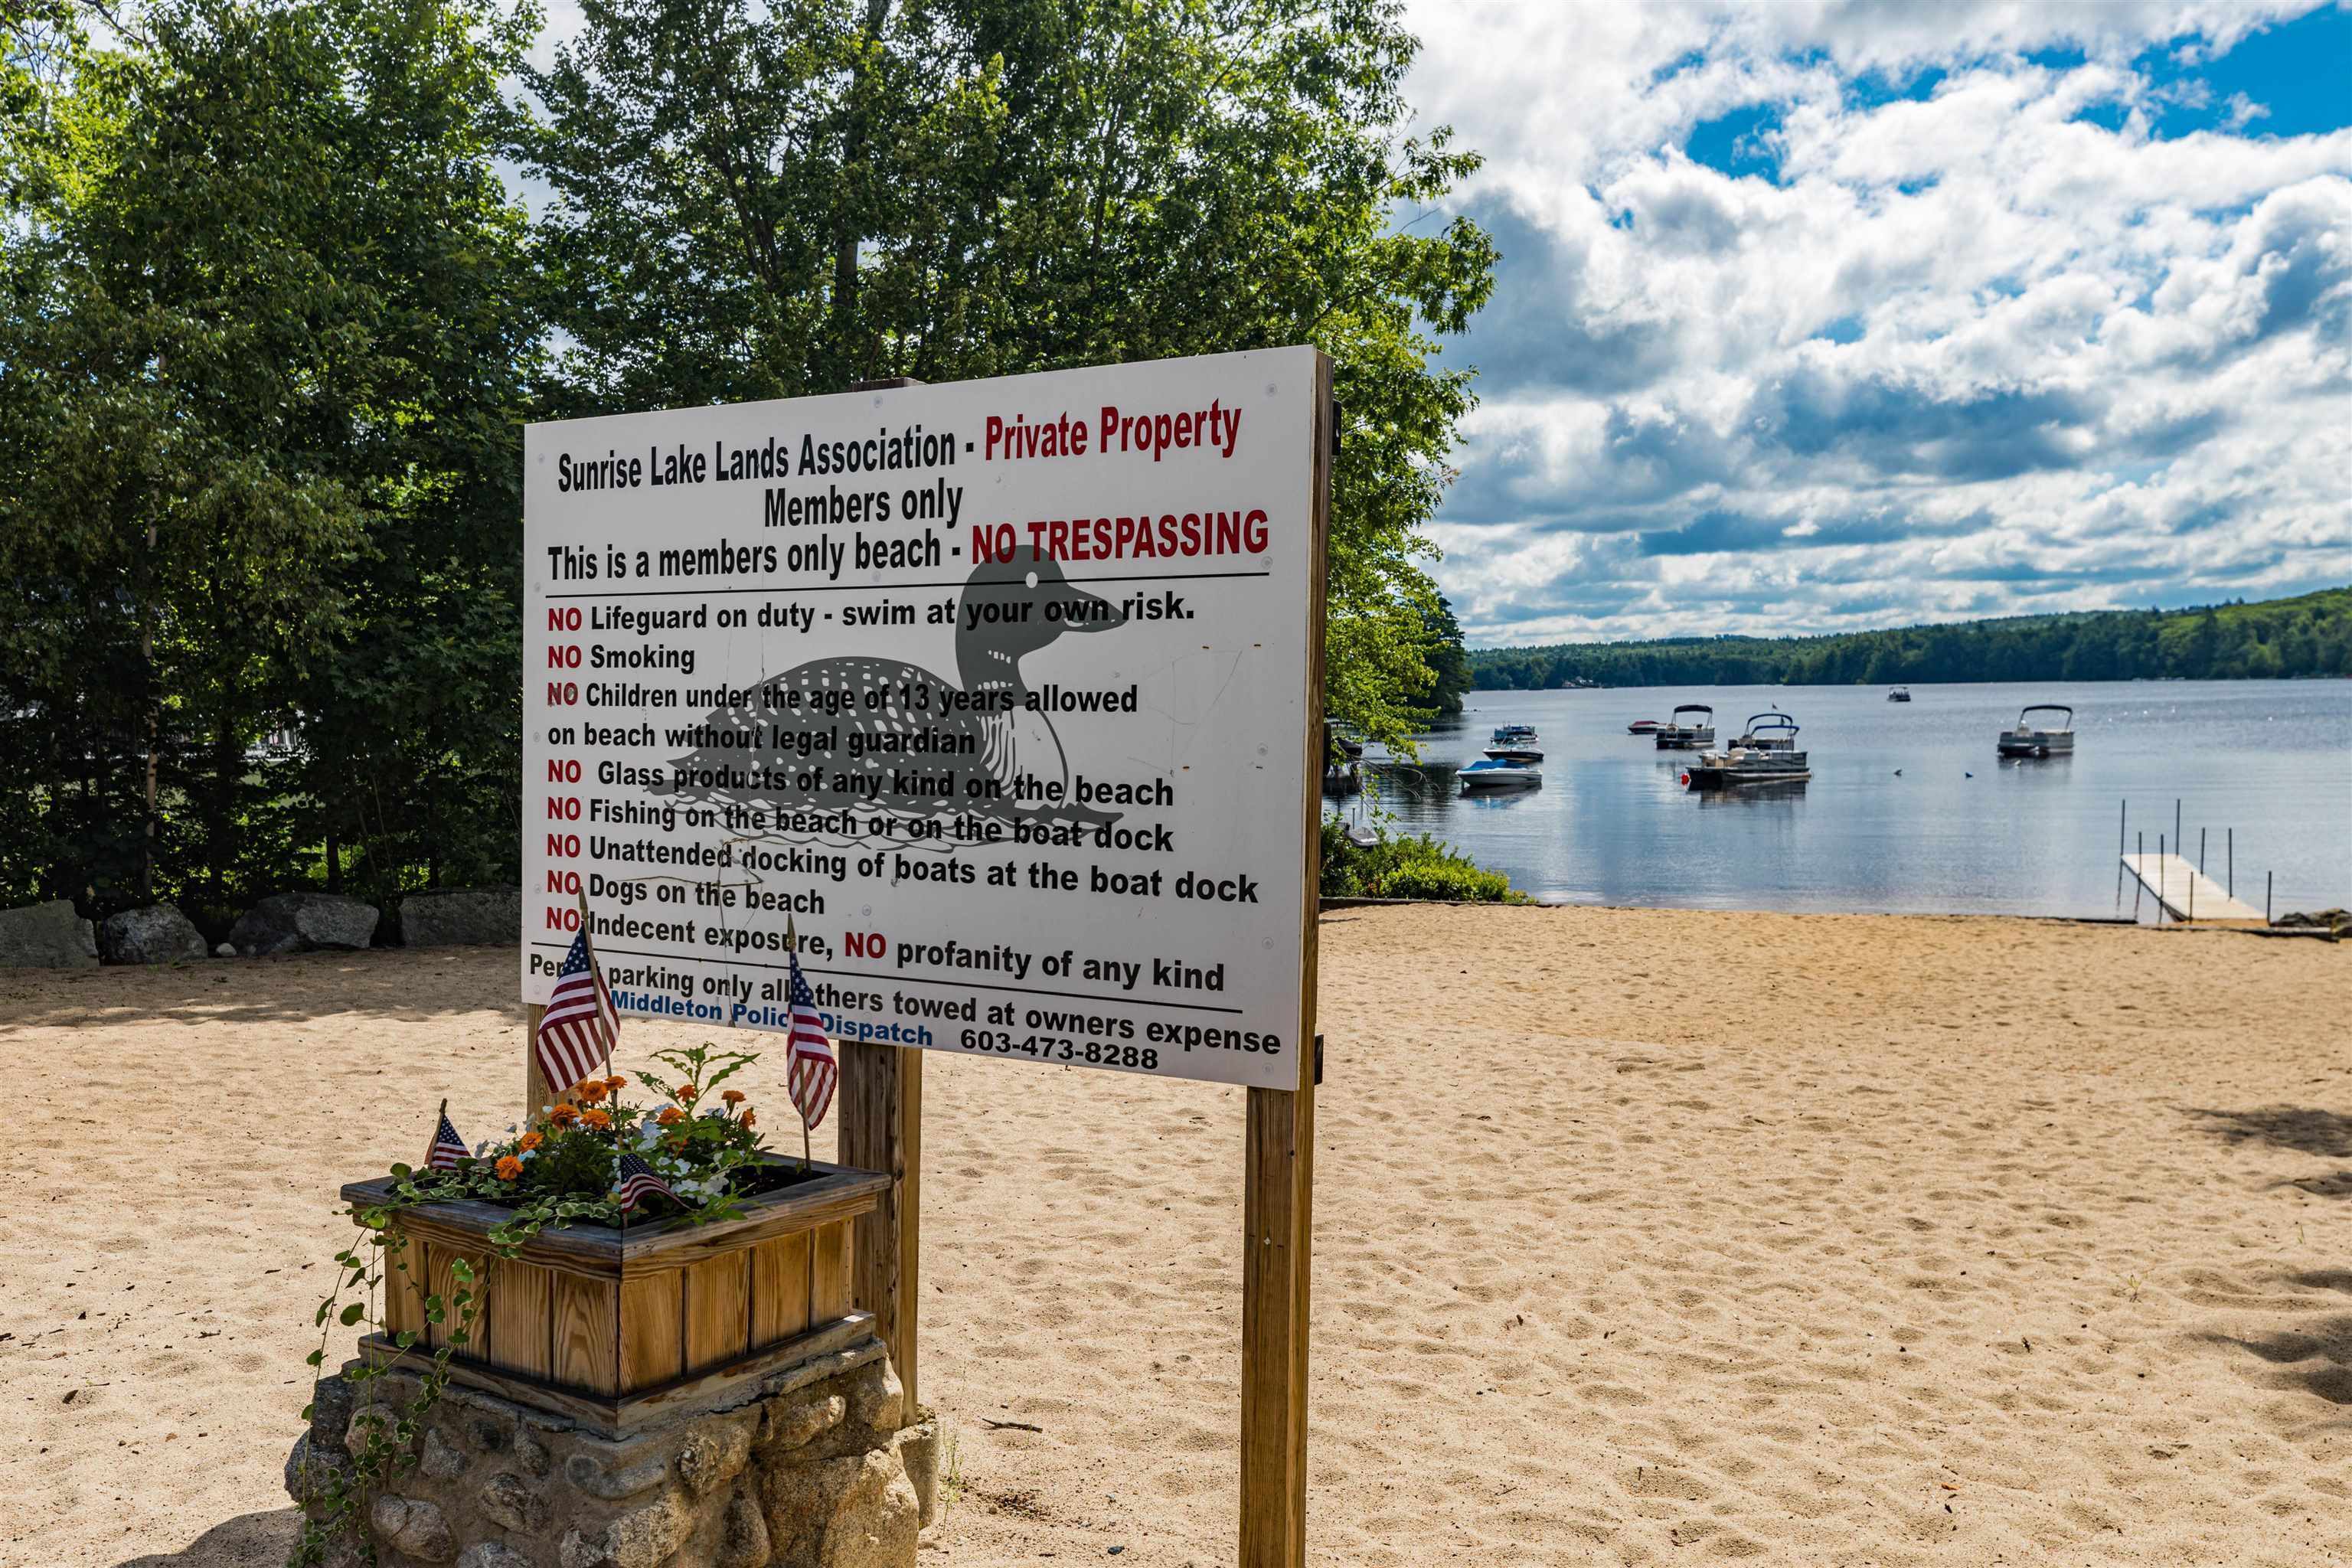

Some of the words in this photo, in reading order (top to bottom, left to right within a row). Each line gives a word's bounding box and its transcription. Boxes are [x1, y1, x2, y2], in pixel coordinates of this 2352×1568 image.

[558, 450, 642, 492] Sunrise
[651, 444, 706, 486] Lake
[716, 436, 789, 482] Lands
[799, 424, 955, 475] Association
[985, 410, 1087, 461] Private
[1100, 398, 1242, 462] Property
[765, 485, 890, 528] Members
[902, 478, 963, 529] only
[547, 544, 598, 580] This
[607, 544, 626, 578] is
[635, 550, 649, 577] a
[659, 538, 777, 577] members
[787, 534, 844, 580] only
[855, 528, 940, 570] beach
[972, 523, 1016, 565] NO
[1027, 509, 1269, 563] TRESPASSING
[547, 606, 582, 632] NO
[591, 603, 707, 635] Lifeguard
[717, 606, 747, 628] on
[757, 602, 815, 632] duty
[842, 599, 916, 626] swim
[927, 598, 956, 624] at
[966, 599, 1034, 630] your
[1044, 596, 1109, 620] own
[1122, 591, 1194, 619] risk.
[547, 645, 582, 668] NO
[590, 644, 695, 674] Smoking
[547, 682, 579, 706] NO
[586, 682, 678, 707] Children
[687, 684, 751, 707] under
[763, 684, 802, 709] the
[810, 688, 855, 715] age
[864, 683, 891, 709] of
[903, 684, 929, 710] 13
[939, 688, 1014, 717] years
[1025, 684, 1138, 712] allowed
[548, 726, 575, 746] on
[584, 722, 655, 746] beach
[665, 724, 763, 749] without
[772, 726, 838, 755] legal
[848, 727, 975, 756] guardian
[547, 760, 581, 783] NO
[598, 760, 664, 786] Glass
[674, 764, 786, 793] products
[797, 766, 823, 792] of
[832, 772, 883, 800] any
[893, 769, 954, 797] kind
[965, 777, 1001, 799] on
[1014, 774, 1063, 802] the
[1075, 776, 1174, 805] beach
[547, 797, 581, 820] NO
[590, 799, 675, 831] Fishing
[685, 807, 715, 827] on
[725, 805, 766, 831] the
[776, 807, 857, 835] beach
[868, 815, 897, 837] or
[907, 817, 942, 839] on
[955, 814, 1001, 841] the
[1014, 817, 1082, 846] boat
[1095, 822, 1174, 852] dock
[547, 834, 580, 858] NO
[590, 836, 731, 868] Unattended
[742, 846, 846, 881] docking
[858, 853, 884, 878] of
[894, 852, 975, 884] boats
[987, 861, 1017, 887] at
[1028, 862, 1078, 890] the
[1090, 865, 1162, 897] boat
[1175, 871, 1259, 903] dock
[547, 871, 580, 895] NO
[590, 873, 648, 906] Dogs
[657, 882, 685, 903] on
[696, 881, 736, 907] the
[746, 884, 825, 914] beach
[547, 906, 580, 932] NO
[590, 911, 695, 944] Indecent
[704, 926, 833, 962] exposure,
[845, 932, 887, 959] NO
[897, 940, 1031, 980] profanity
[1042, 950, 1073, 977] of
[1083, 959, 1141, 990] any
[1153, 959, 1224, 991] kind
[609, 964, 694, 998] parking
[703, 974, 753, 1004] only
[761, 978, 790, 1002] all
[806, 983, 883, 1011] thers
[893, 990, 976, 1021] towed
[987, 1001, 1014, 1025] at
[1025, 1010, 1134, 1039] owners
[1146, 1022, 1281, 1054] expense
[611, 990, 722, 1021] Middleton
[733, 1003, 789, 1027] Polic
[819, 1012, 933, 1047] Dispatch
[961, 1029, 1158, 1070] 603-473-8288
